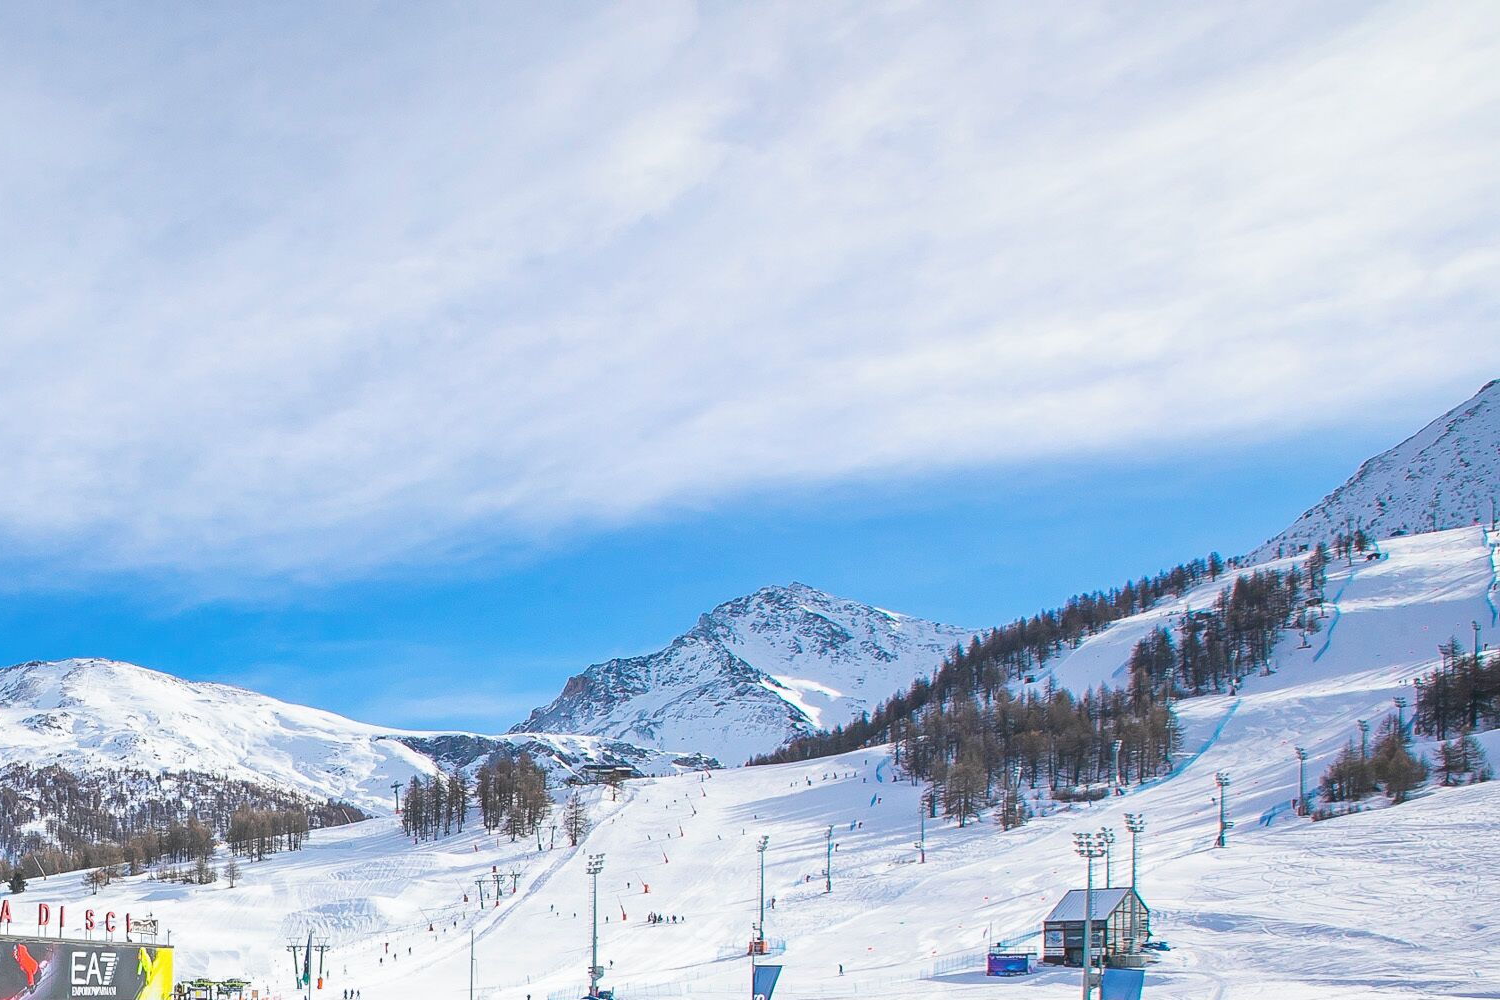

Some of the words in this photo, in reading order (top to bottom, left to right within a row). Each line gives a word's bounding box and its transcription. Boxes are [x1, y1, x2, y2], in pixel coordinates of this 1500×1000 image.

[38, 903, 66, 928] DI
[71, 951, 117, 986] EA7
[72, 986, 96, 997] EMPORIO
[98, 986, 116, 997] ARMANI
